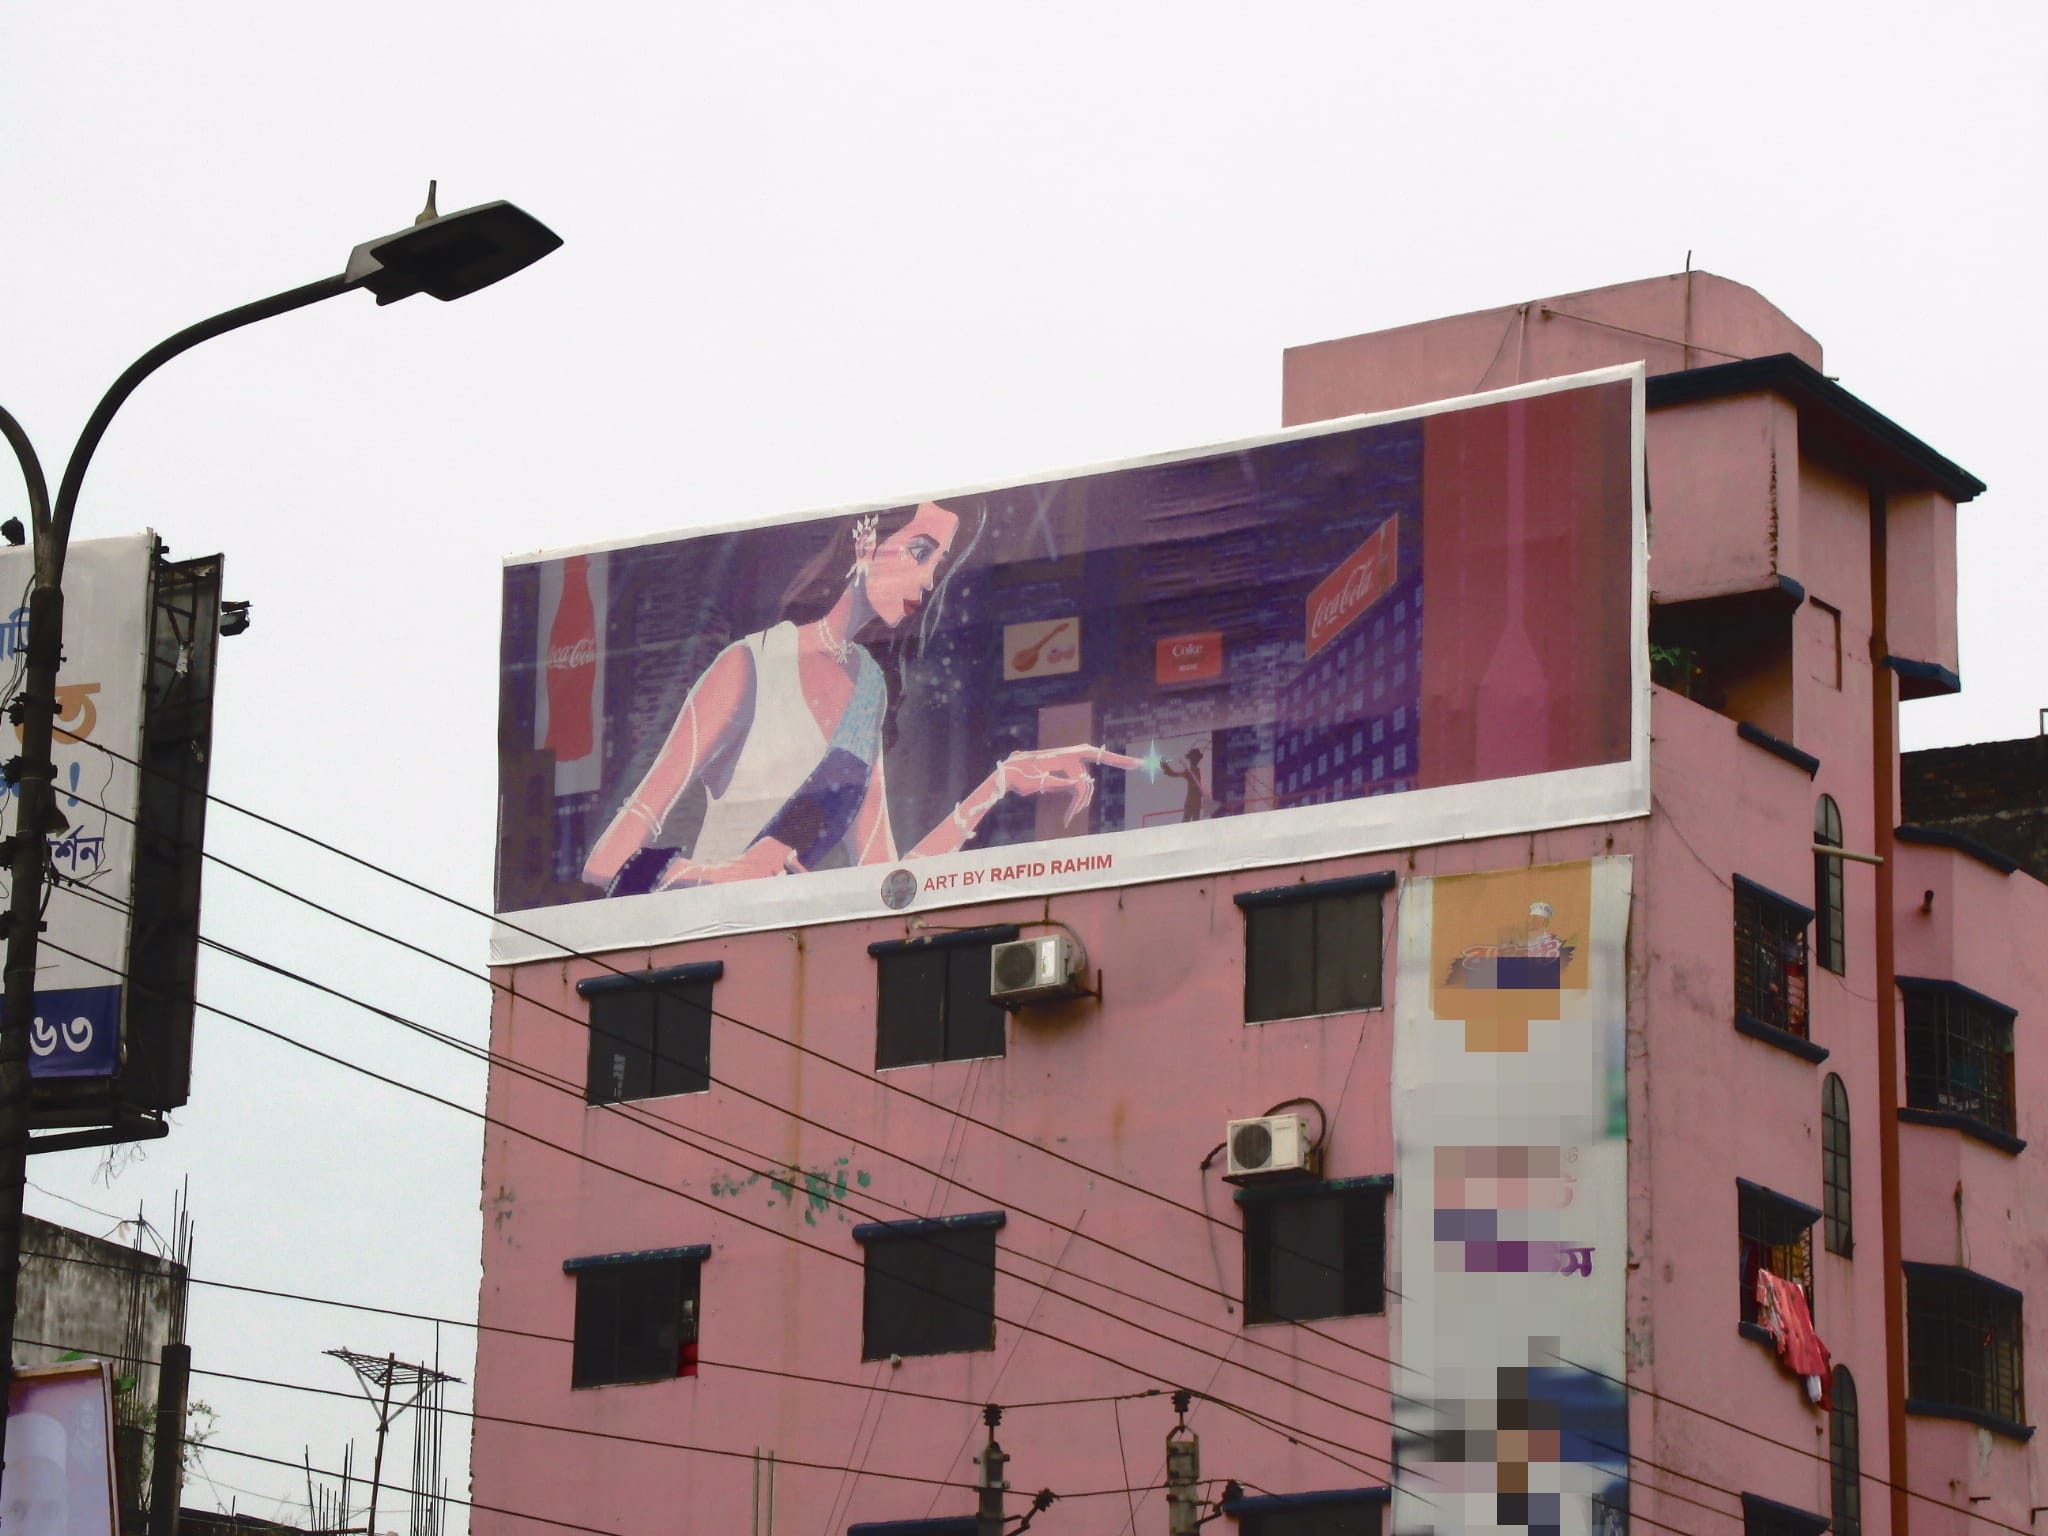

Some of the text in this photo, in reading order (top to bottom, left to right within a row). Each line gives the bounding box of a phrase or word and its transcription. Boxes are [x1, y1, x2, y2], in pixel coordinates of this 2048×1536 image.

[1172, 643, 1204, 658] Coke
[48, 825, 104, 872] র্শন
[923, 854, 1113, 892] ART BY RAFID RAHIM
[30, 1016, 93, 1056] ৬৩
